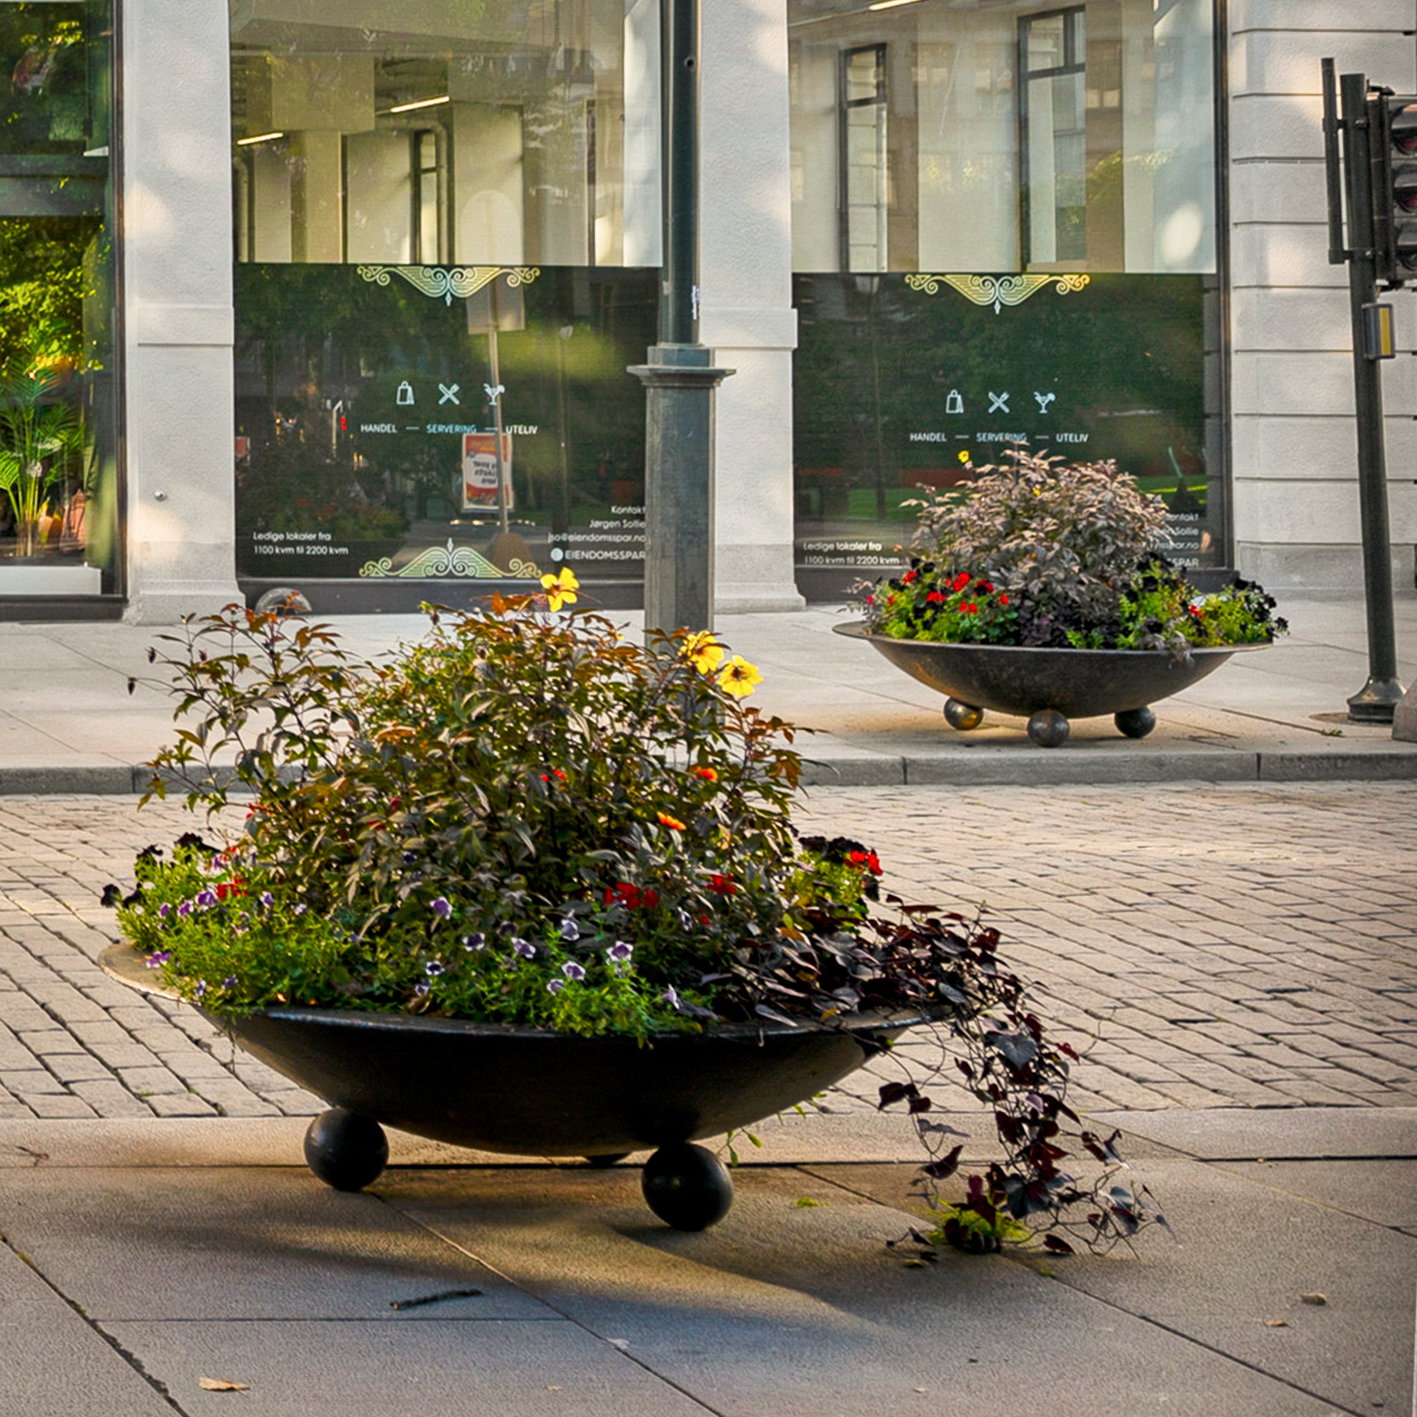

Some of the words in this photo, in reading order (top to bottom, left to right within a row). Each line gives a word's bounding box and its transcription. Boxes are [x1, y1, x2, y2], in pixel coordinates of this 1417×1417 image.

[360, 423, 397, 433] HANDEL
[426, 424, 477, 434] SERVERING
[505, 425, 538, 434] UTELIV
[909, 432, 947, 443] HANDEL
[976, 432, 1027, 443] SERVERING
[1056, 432, 1089, 443] UTELIV
[611, 505, 646, 514] Kontakt
[253, 531, 285, 542] Ledige
[286, 531, 317, 540] lokaler
[318, 531, 332, 541] fra
[254, 545, 274, 555] 1100
[275, 545, 295, 554] kvm
[306, 545, 328, 555] 2200
[329, 545, 349, 555] kvm
[803, 541, 834, 552] Ledige
[836, 542, 867, 551] lokaler
[869, 542, 882, 551] fra
[565, 550, 646, 560] EIENDOMSSPAR
[805, 556, 824, 565] 1100
[826, 556, 846, 565] kvm
[856, 556, 879, 565] 2200
[880, 556, 900, 565] kvm
